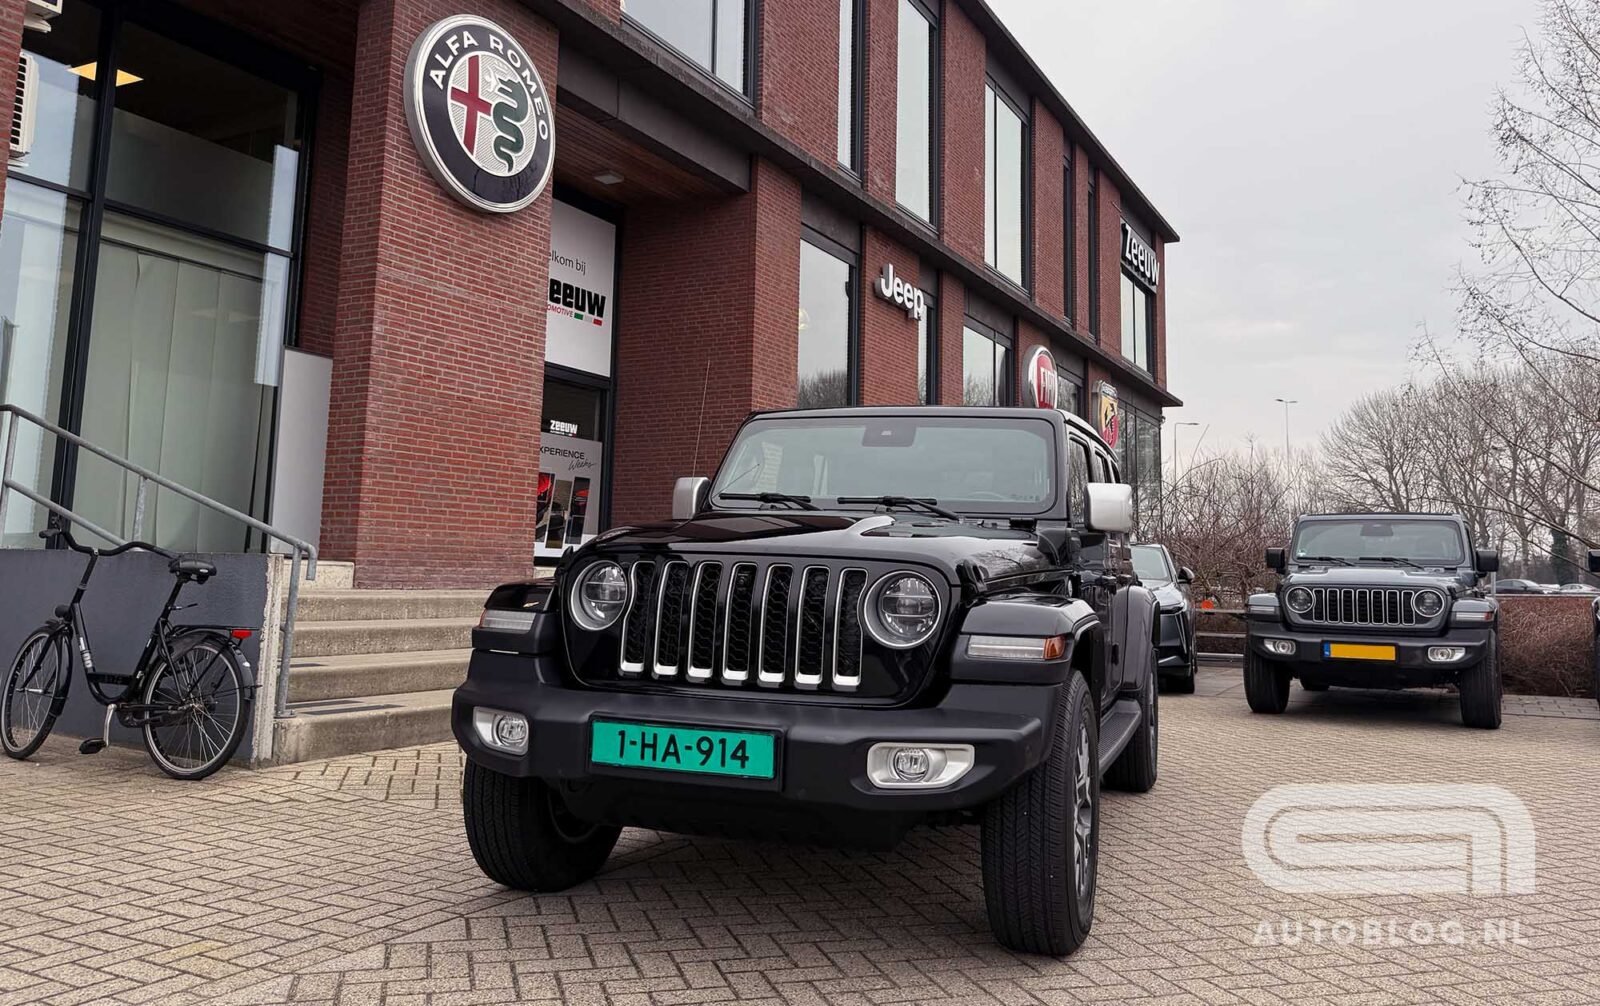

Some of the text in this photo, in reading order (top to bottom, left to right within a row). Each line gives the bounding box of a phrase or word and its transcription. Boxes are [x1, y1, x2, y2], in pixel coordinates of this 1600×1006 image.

[429, 31, 548, 140] ALFA ROMEO
[575, 259, 586, 276] bij
[881, 263, 924, 320] Jeep
[618, 730, 749, 769] 1-HA-914
